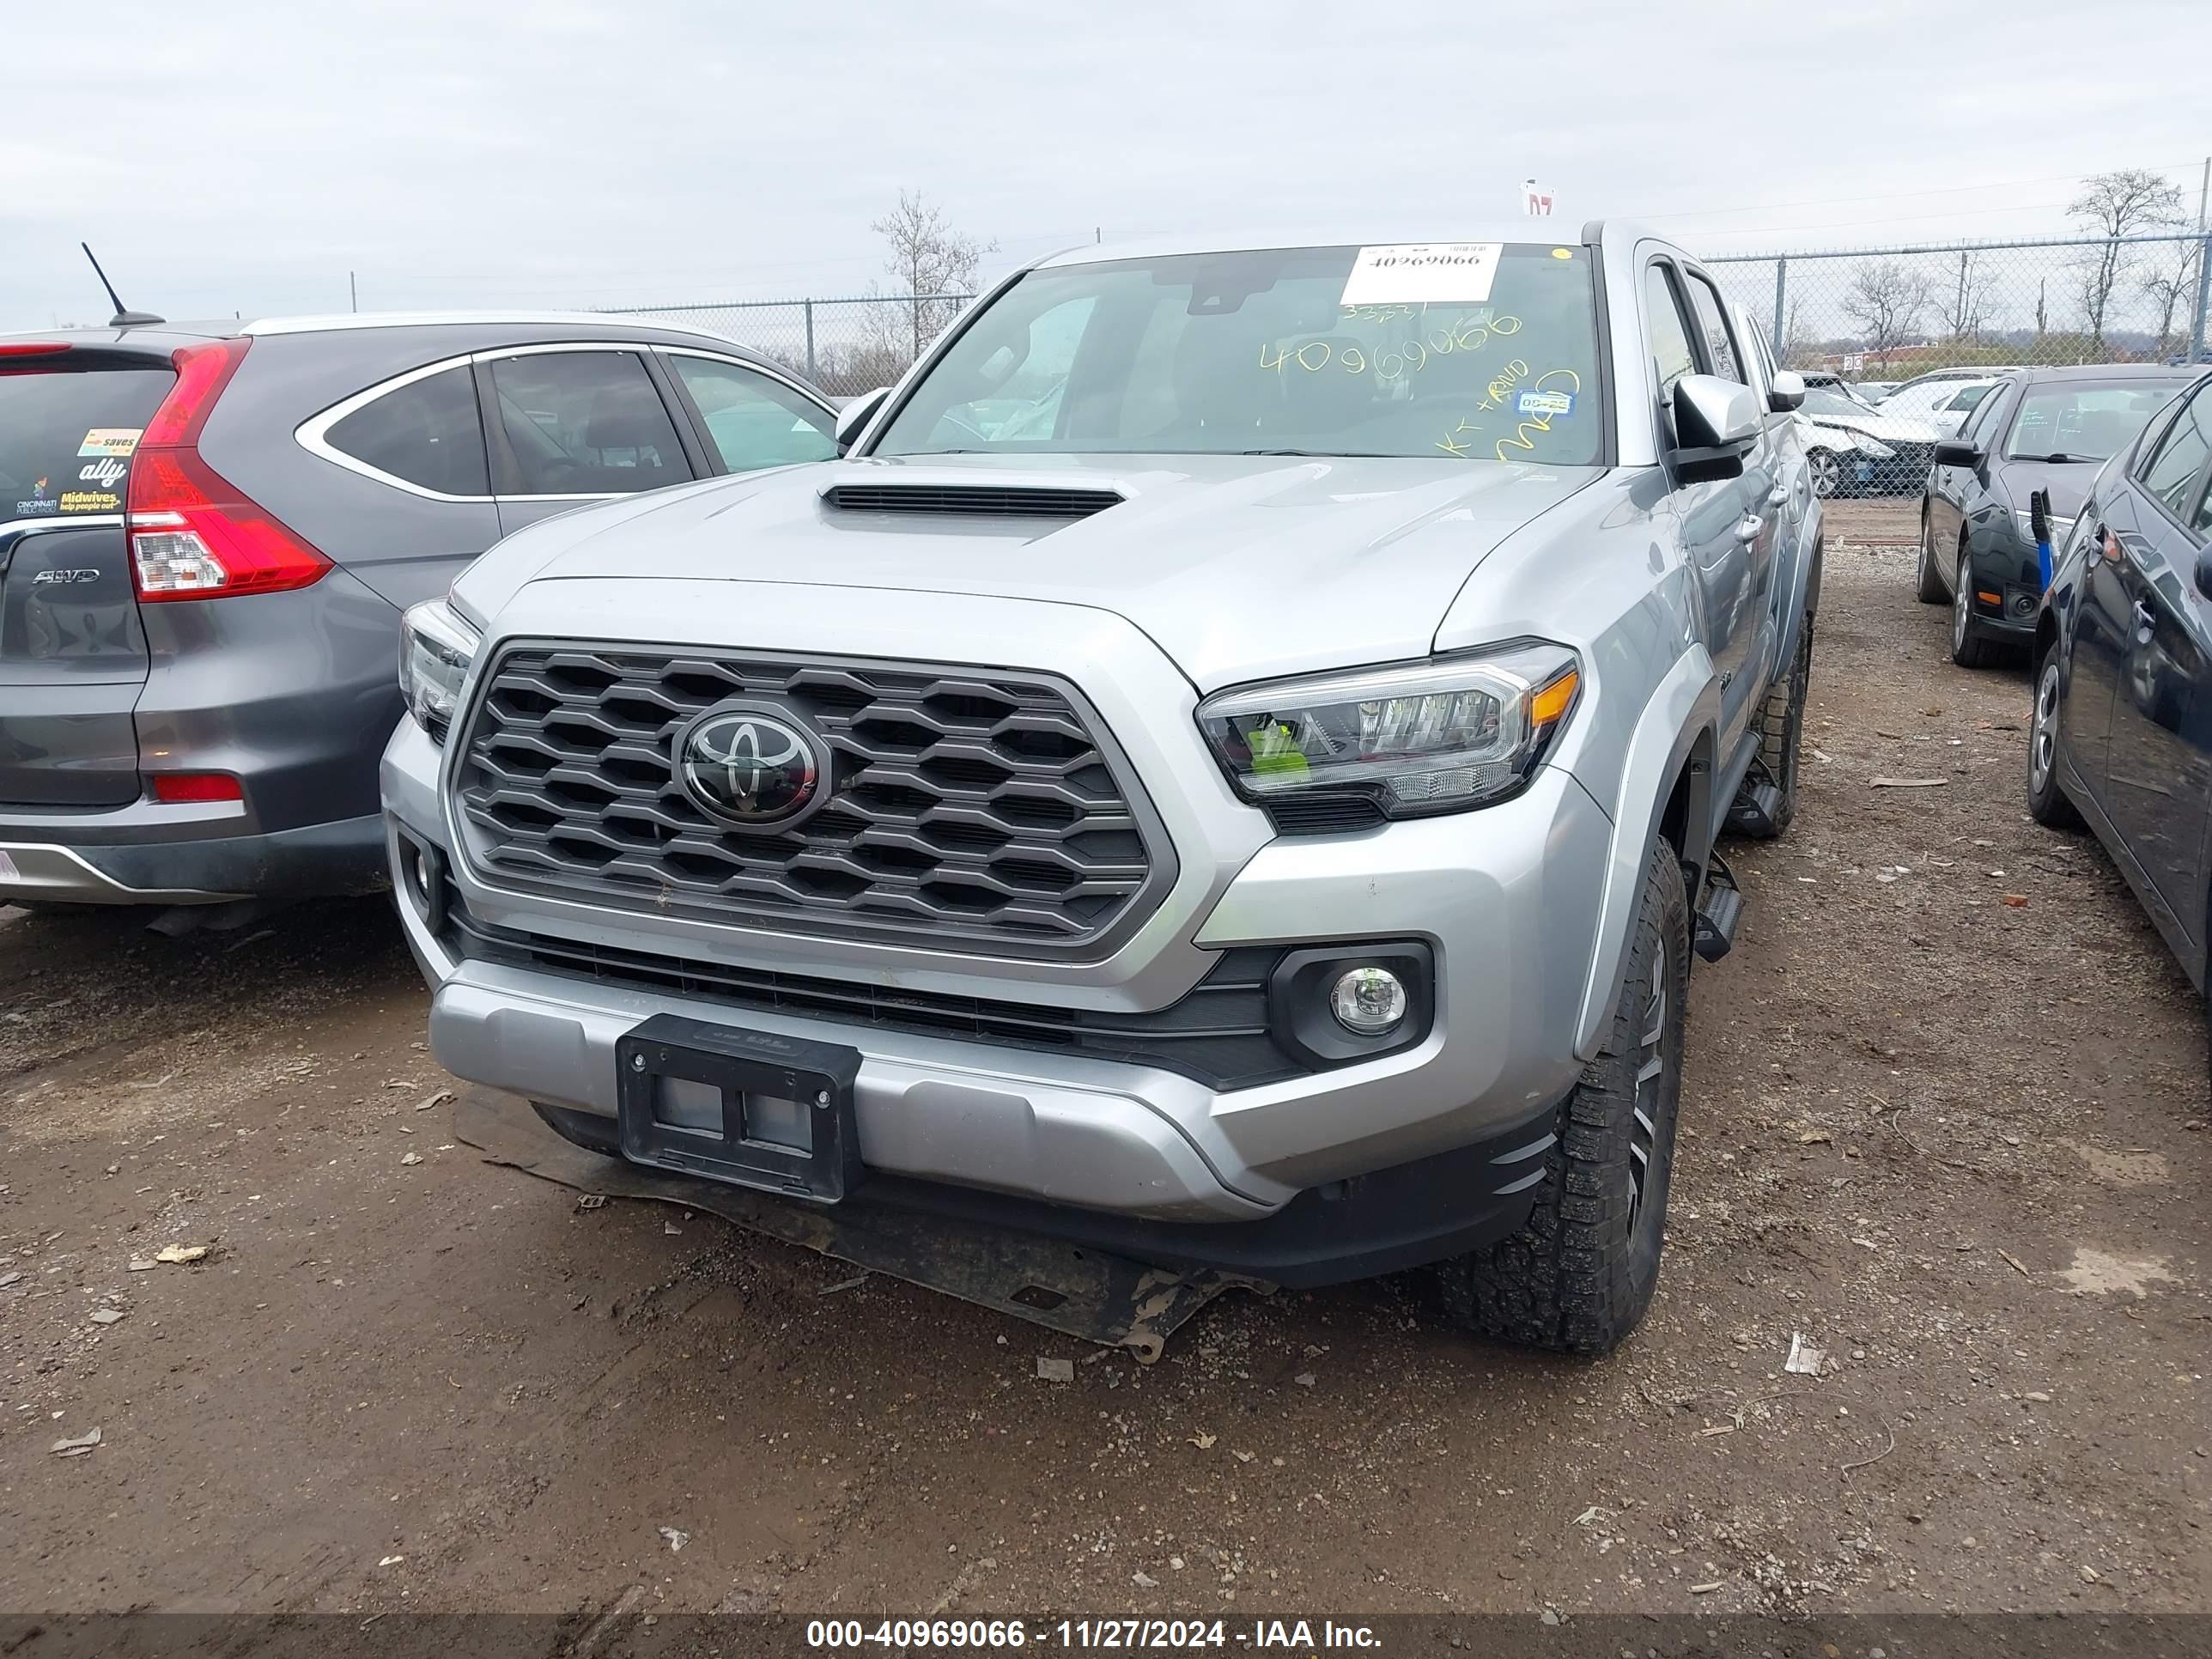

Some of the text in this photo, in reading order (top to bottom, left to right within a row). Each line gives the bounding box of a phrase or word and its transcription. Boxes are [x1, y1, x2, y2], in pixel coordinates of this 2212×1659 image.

[1369, 255, 1480, 268] 40969066
[103, 438, 135, 447] saves
[79, 458, 127, 488] ally
[61, 490, 117, 503] Midwives
[16, 500, 57, 508] CINCINNATI
[59, 502, 75, 512] help
[75, 502, 100, 511] people
[32, 568, 100, 585] AWD
